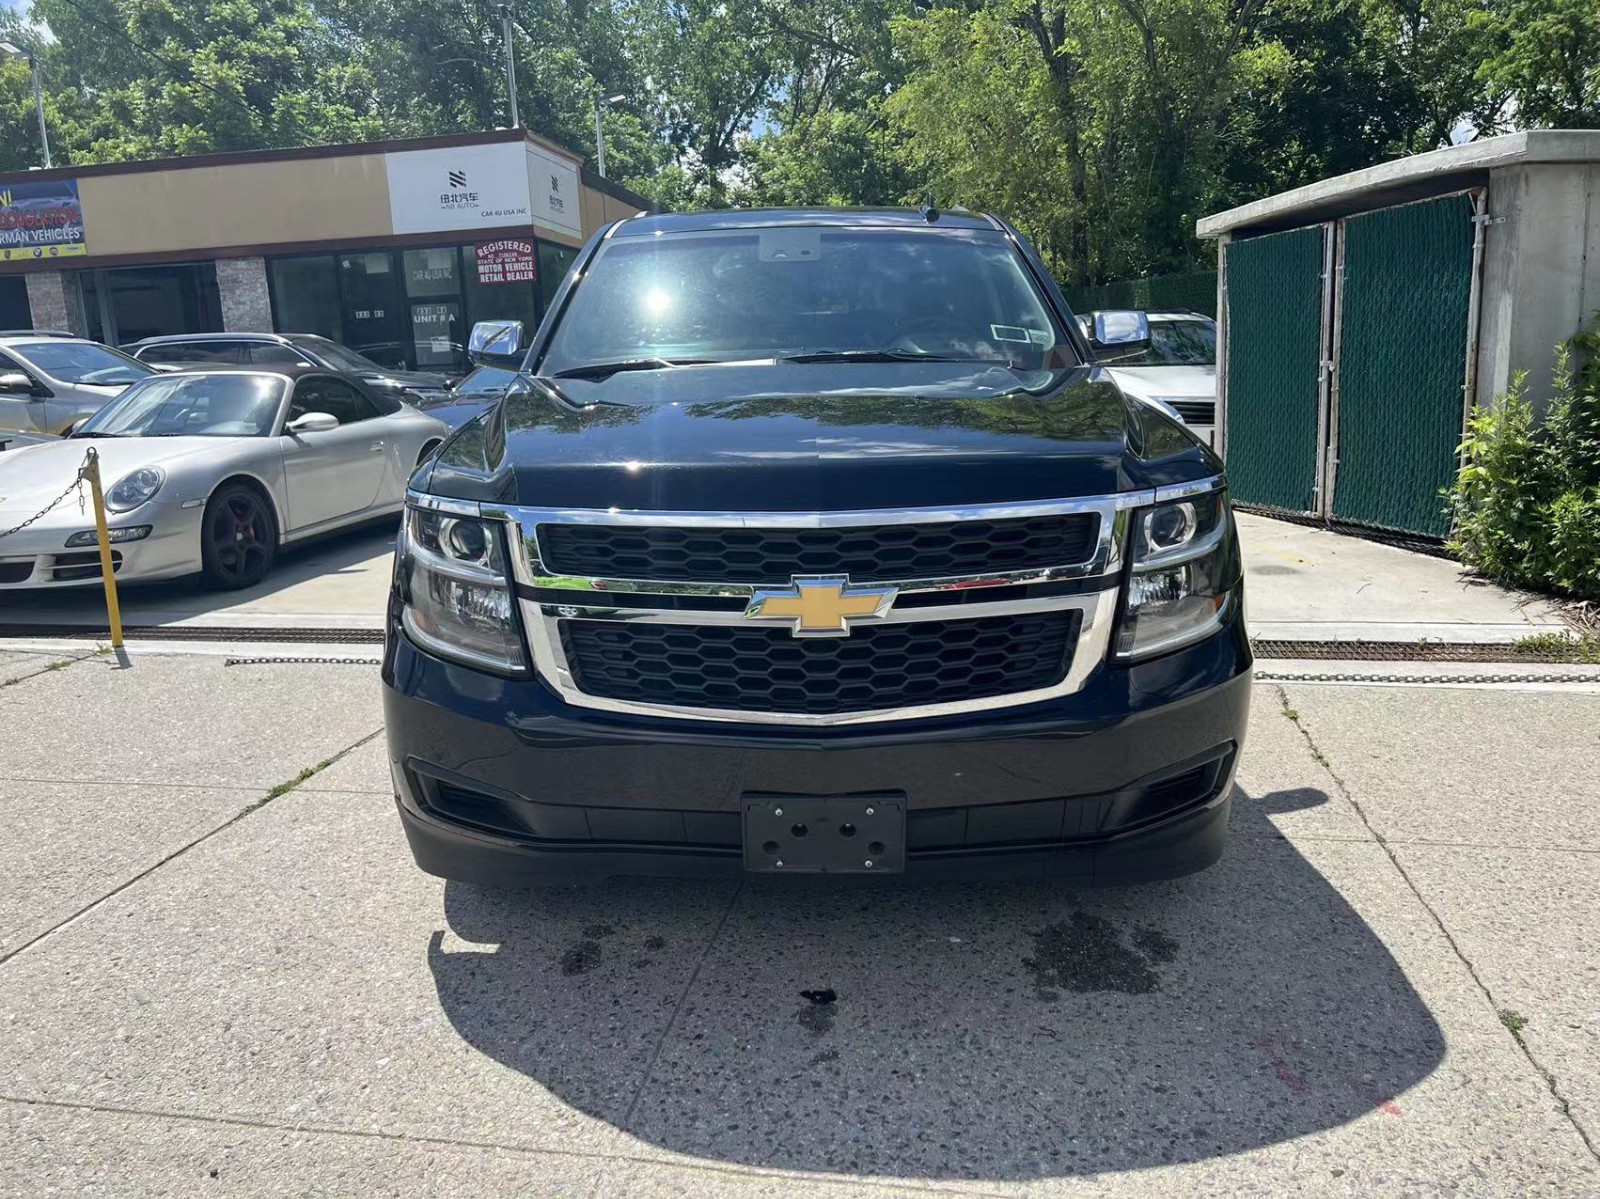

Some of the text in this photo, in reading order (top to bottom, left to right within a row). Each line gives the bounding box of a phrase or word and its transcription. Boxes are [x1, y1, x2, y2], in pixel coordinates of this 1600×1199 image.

[31, 226, 80, 241] VEHICLES
[477, 240, 532, 258] REGISTERED
[478, 262, 534, 273] MOTOR VEHICLE
[480, 271, 534, 283] RETAIL DEALER
[414, 313, 456, 323] UNIT # A
